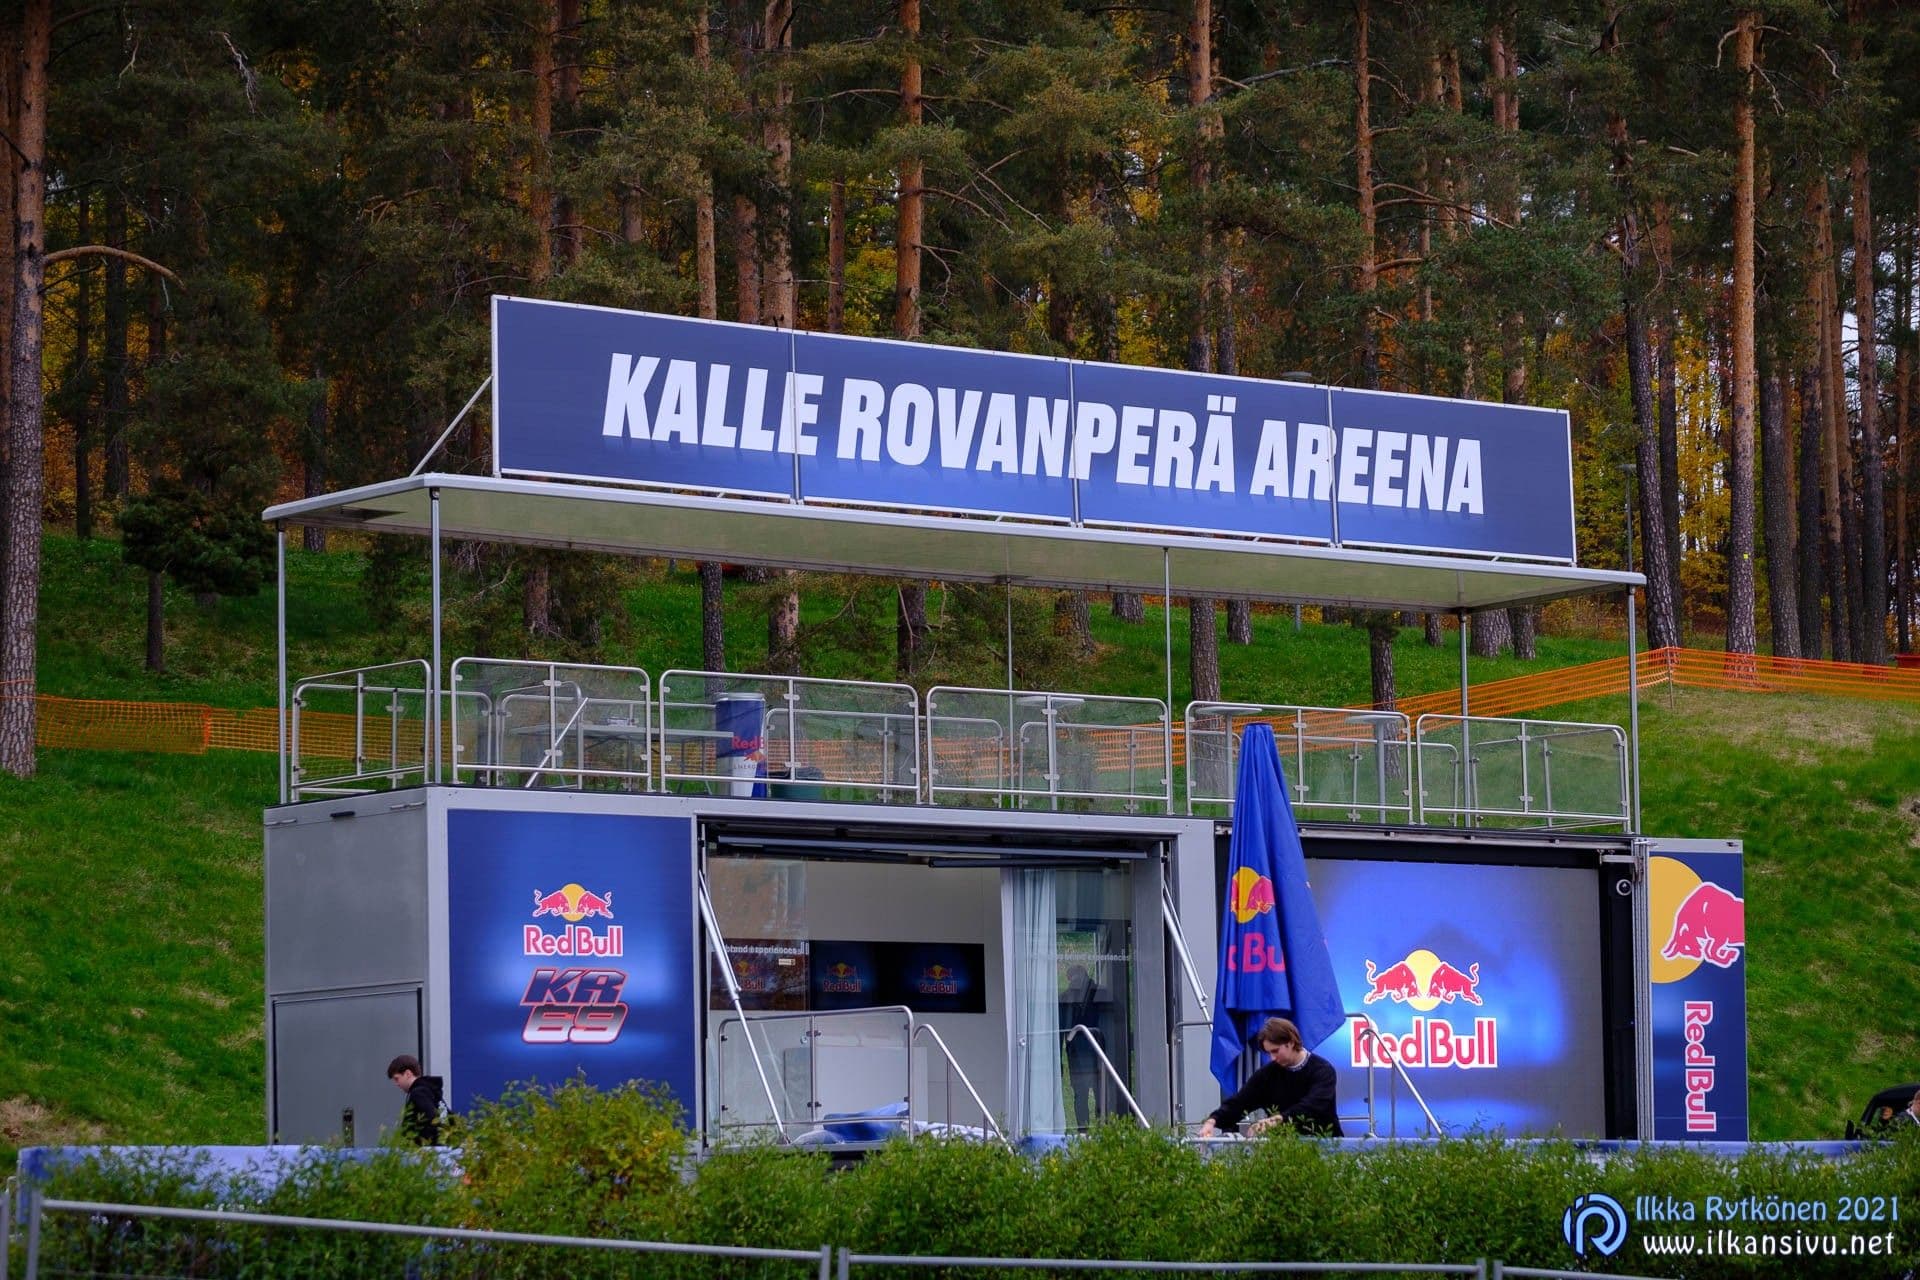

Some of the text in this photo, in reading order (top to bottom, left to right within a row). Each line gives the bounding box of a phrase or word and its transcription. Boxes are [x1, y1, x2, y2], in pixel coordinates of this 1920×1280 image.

[602, 352, 1485, 515] KALLE ROVANPERÄ AREENA
[524, 925, 623, 957] Red Bull
[520, 967, 628, 1006] KR
[522, 1003, 628, 1044] 69
[1427, 1018, 1498, 1069] Bull
[1684, 1001, 1717, 1132] Red Bull
